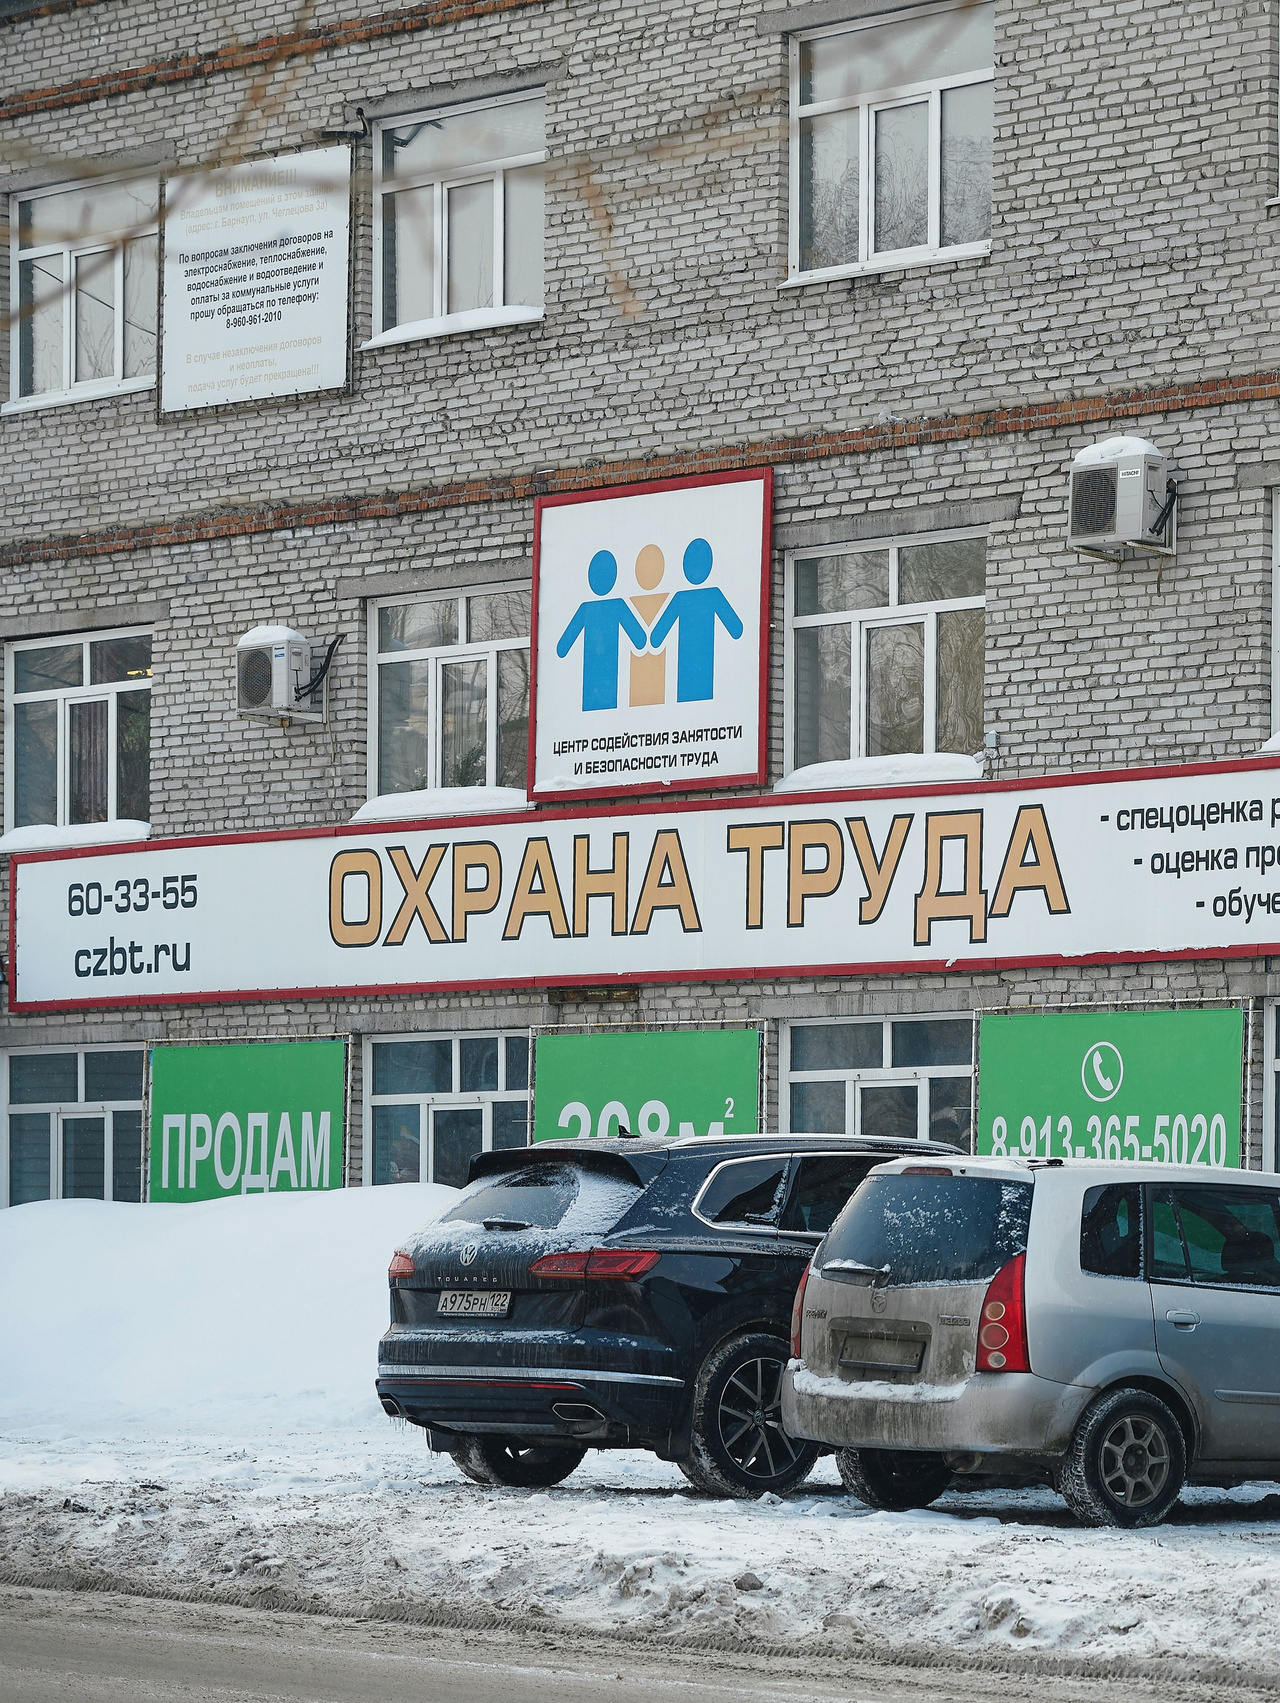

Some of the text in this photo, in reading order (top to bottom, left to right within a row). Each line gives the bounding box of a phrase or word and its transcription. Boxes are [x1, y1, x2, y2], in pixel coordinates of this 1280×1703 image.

[215, 168, 297, 197] ВНИМАНИЕ!!!
[180, 204, 228, 220] Владельцам
[230, 194, 275, 211] помещений
[277, 194, 283, 203] в
[284, 191, 303, 201] этом
[185, 221, 213, 236] (адрес:
[214, 221, 220, 229] г.
[221, 214, 257, 228] Барнаул,
[258, 212, 270, 223] ул.
[272, 203, 314, 218] Чеглецова
[179, 230, 333, 264] По вопросам заключения договоров на
[184, 246, 327, 277] электроснабжение, теплоснабжение,
[187, 261, 324, 292] водоснабжение и водоотведение и
[190, 277, 320, 305] оплаты за коммунальные услуги
[190, 292, 319, 322] прошу обращаться по телефону:
[226, 310, 282, 329] 8-960-961-2010
[186, 336, 322, 365] В случае незаключения договоров
[236, 358, 277, 372] неоплаты,
[188, 363, 320, 393] подача услуг будет прекращена!!!
[553, 725, 742, 756] ЦЕНТР СОДЕЙСТВИЯ ЗАНЯТОСТИ
[574, 750, 719, 775] И БЕЗОПАСНОСТИ ТРУДА
[1116, 797, 1264, 833] спецоценка
[328, 803, 1071, 949] ОХРАНА ТРУДА
[1150, 847, 1238, 879] оценка
[68, 874, 198, 917] 60-33-55
[74, 936, 191, 978] czbt.ru
[161, 1111, 331, 1194] ПРОДАМ
[991, 1113, 1227, 1168] 8-913-365-5020
[440, 1292, 508, 1311] А975РН 122
